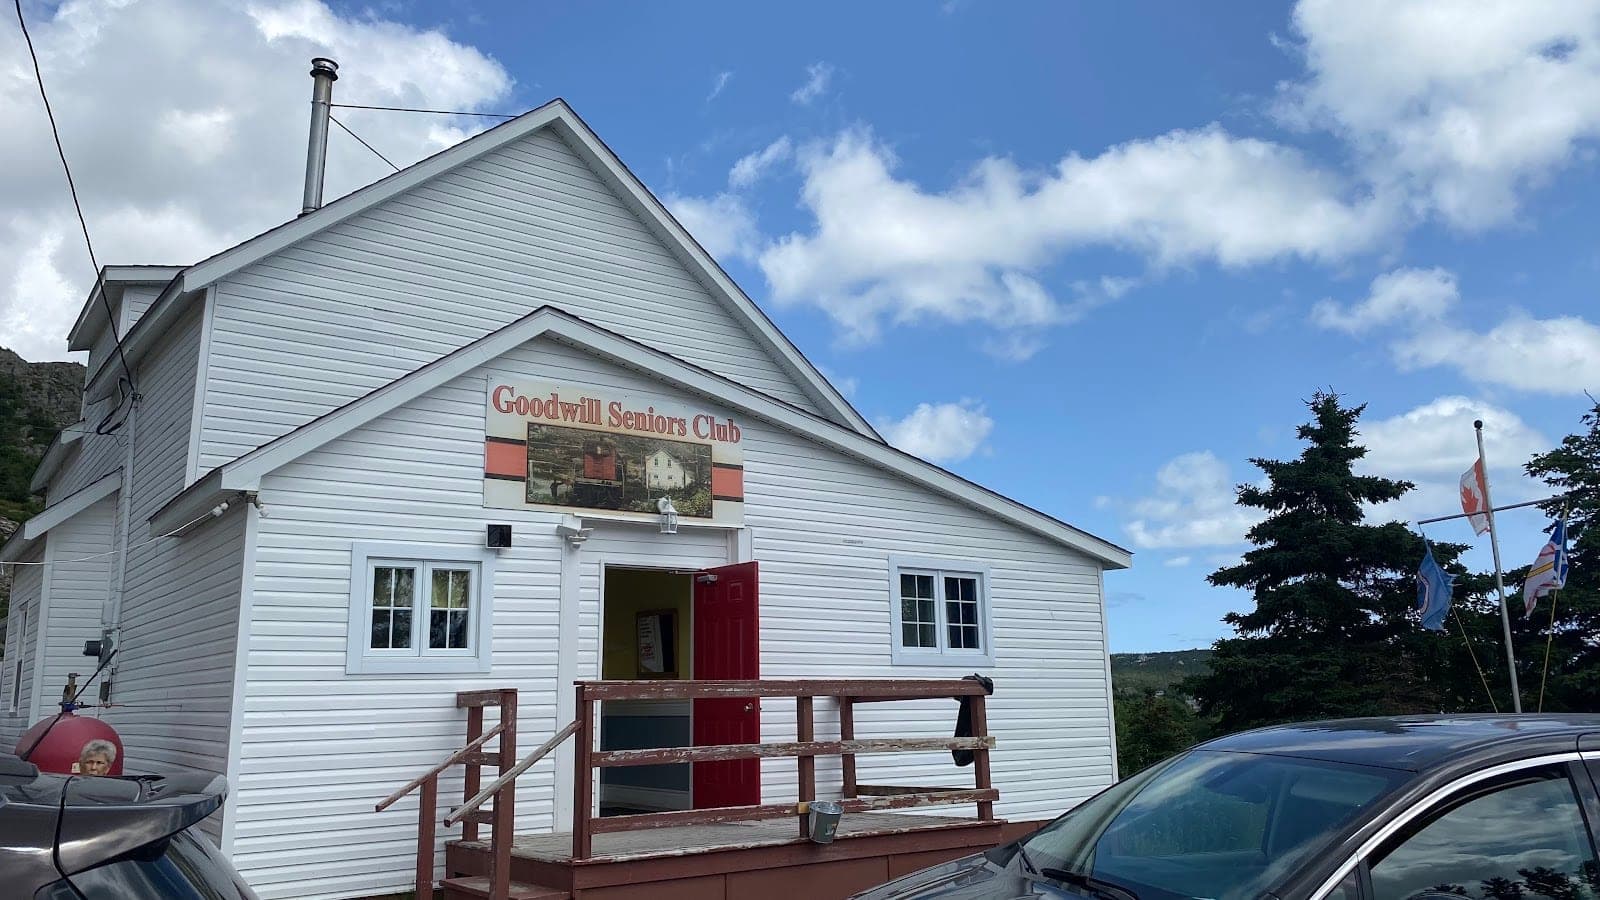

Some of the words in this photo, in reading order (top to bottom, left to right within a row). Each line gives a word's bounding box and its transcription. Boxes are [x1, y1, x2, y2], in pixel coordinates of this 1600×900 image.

[492, 385, 602, 425] Goodwill
[608, 401, 687, 437] Seniors
[692, 414, 741, 443] Club
